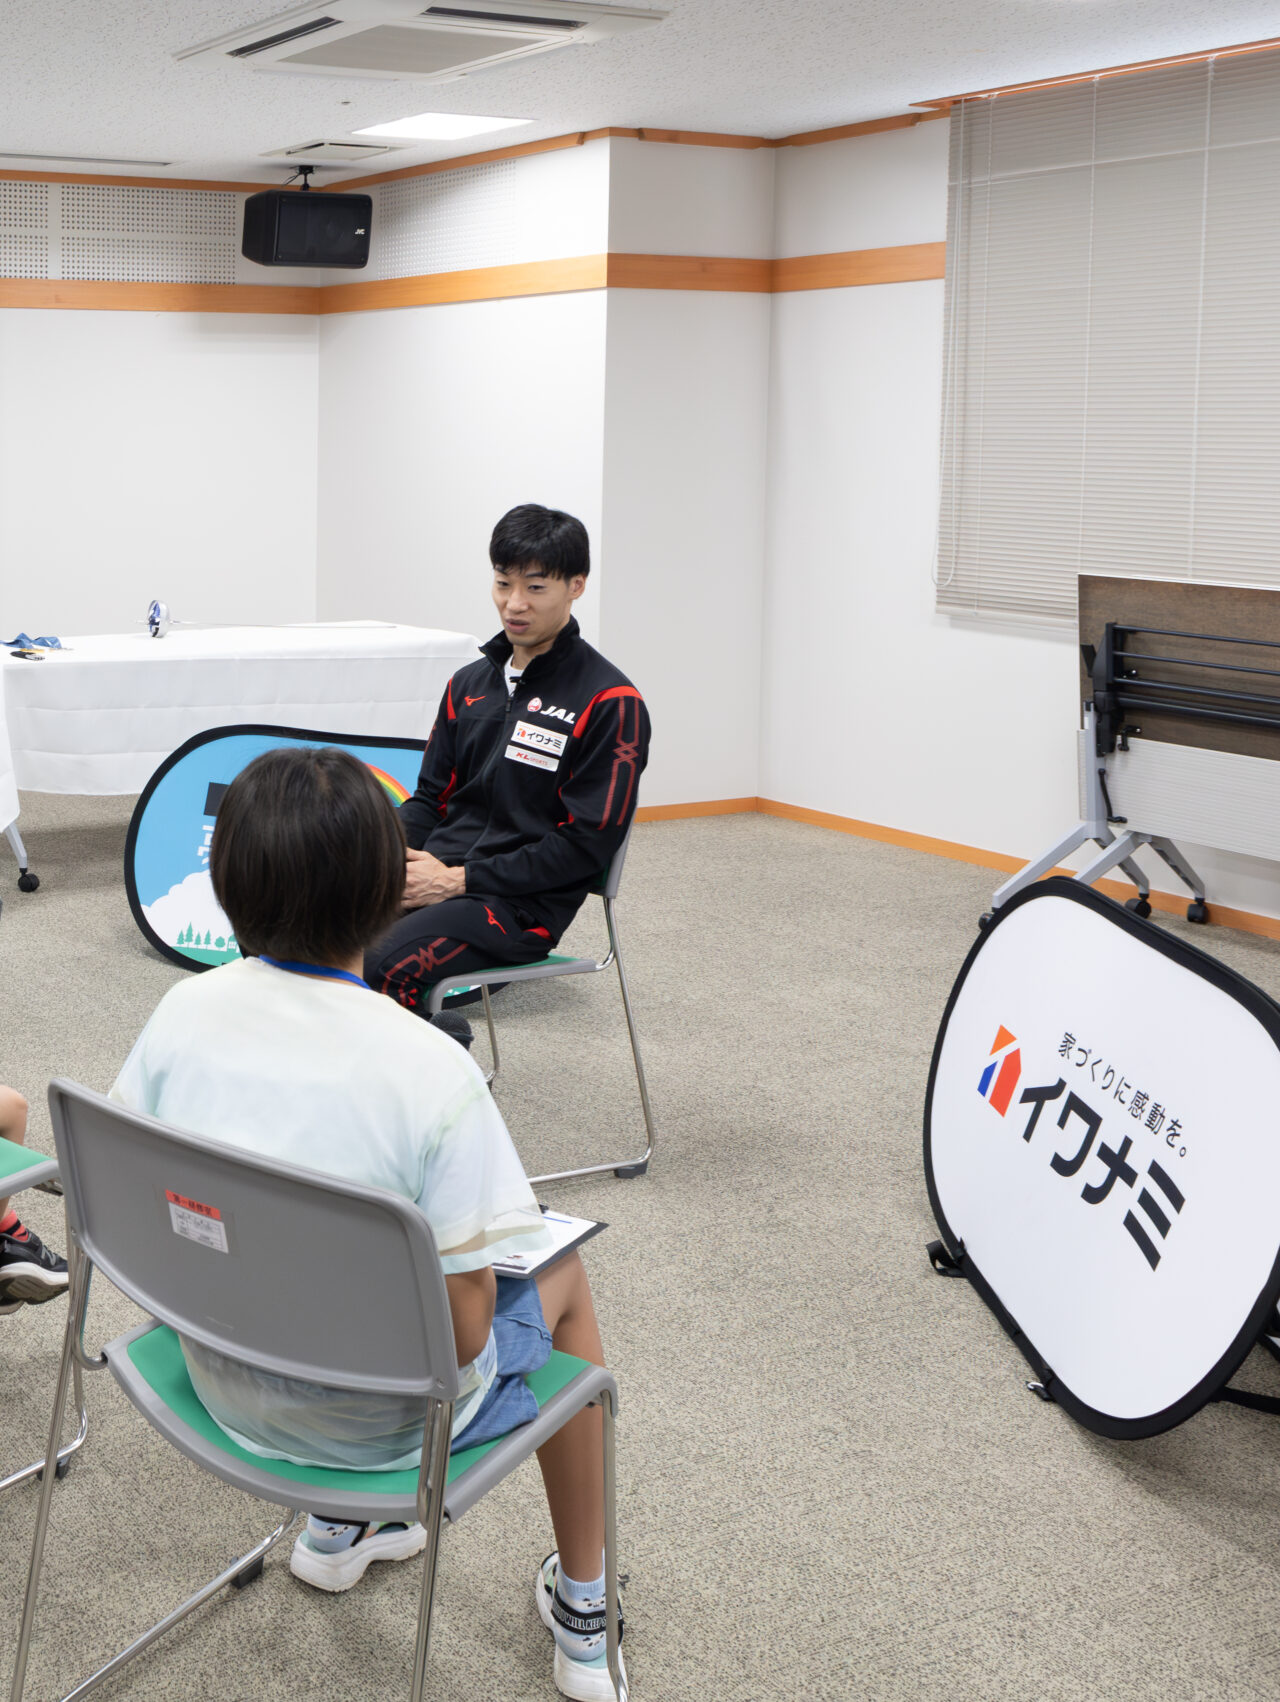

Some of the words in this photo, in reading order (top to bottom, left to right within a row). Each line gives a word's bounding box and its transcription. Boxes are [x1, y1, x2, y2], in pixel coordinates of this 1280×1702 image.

[540, 705, 576, 725] JAL
[527, 732, 562, 749] イワナミ
[1058, 1032, 1187, 1157] 家づくりに感動を。
[1019, 1077, 1186, 1272] イワナミ
[564, 1614, 586, 1630] WILL
